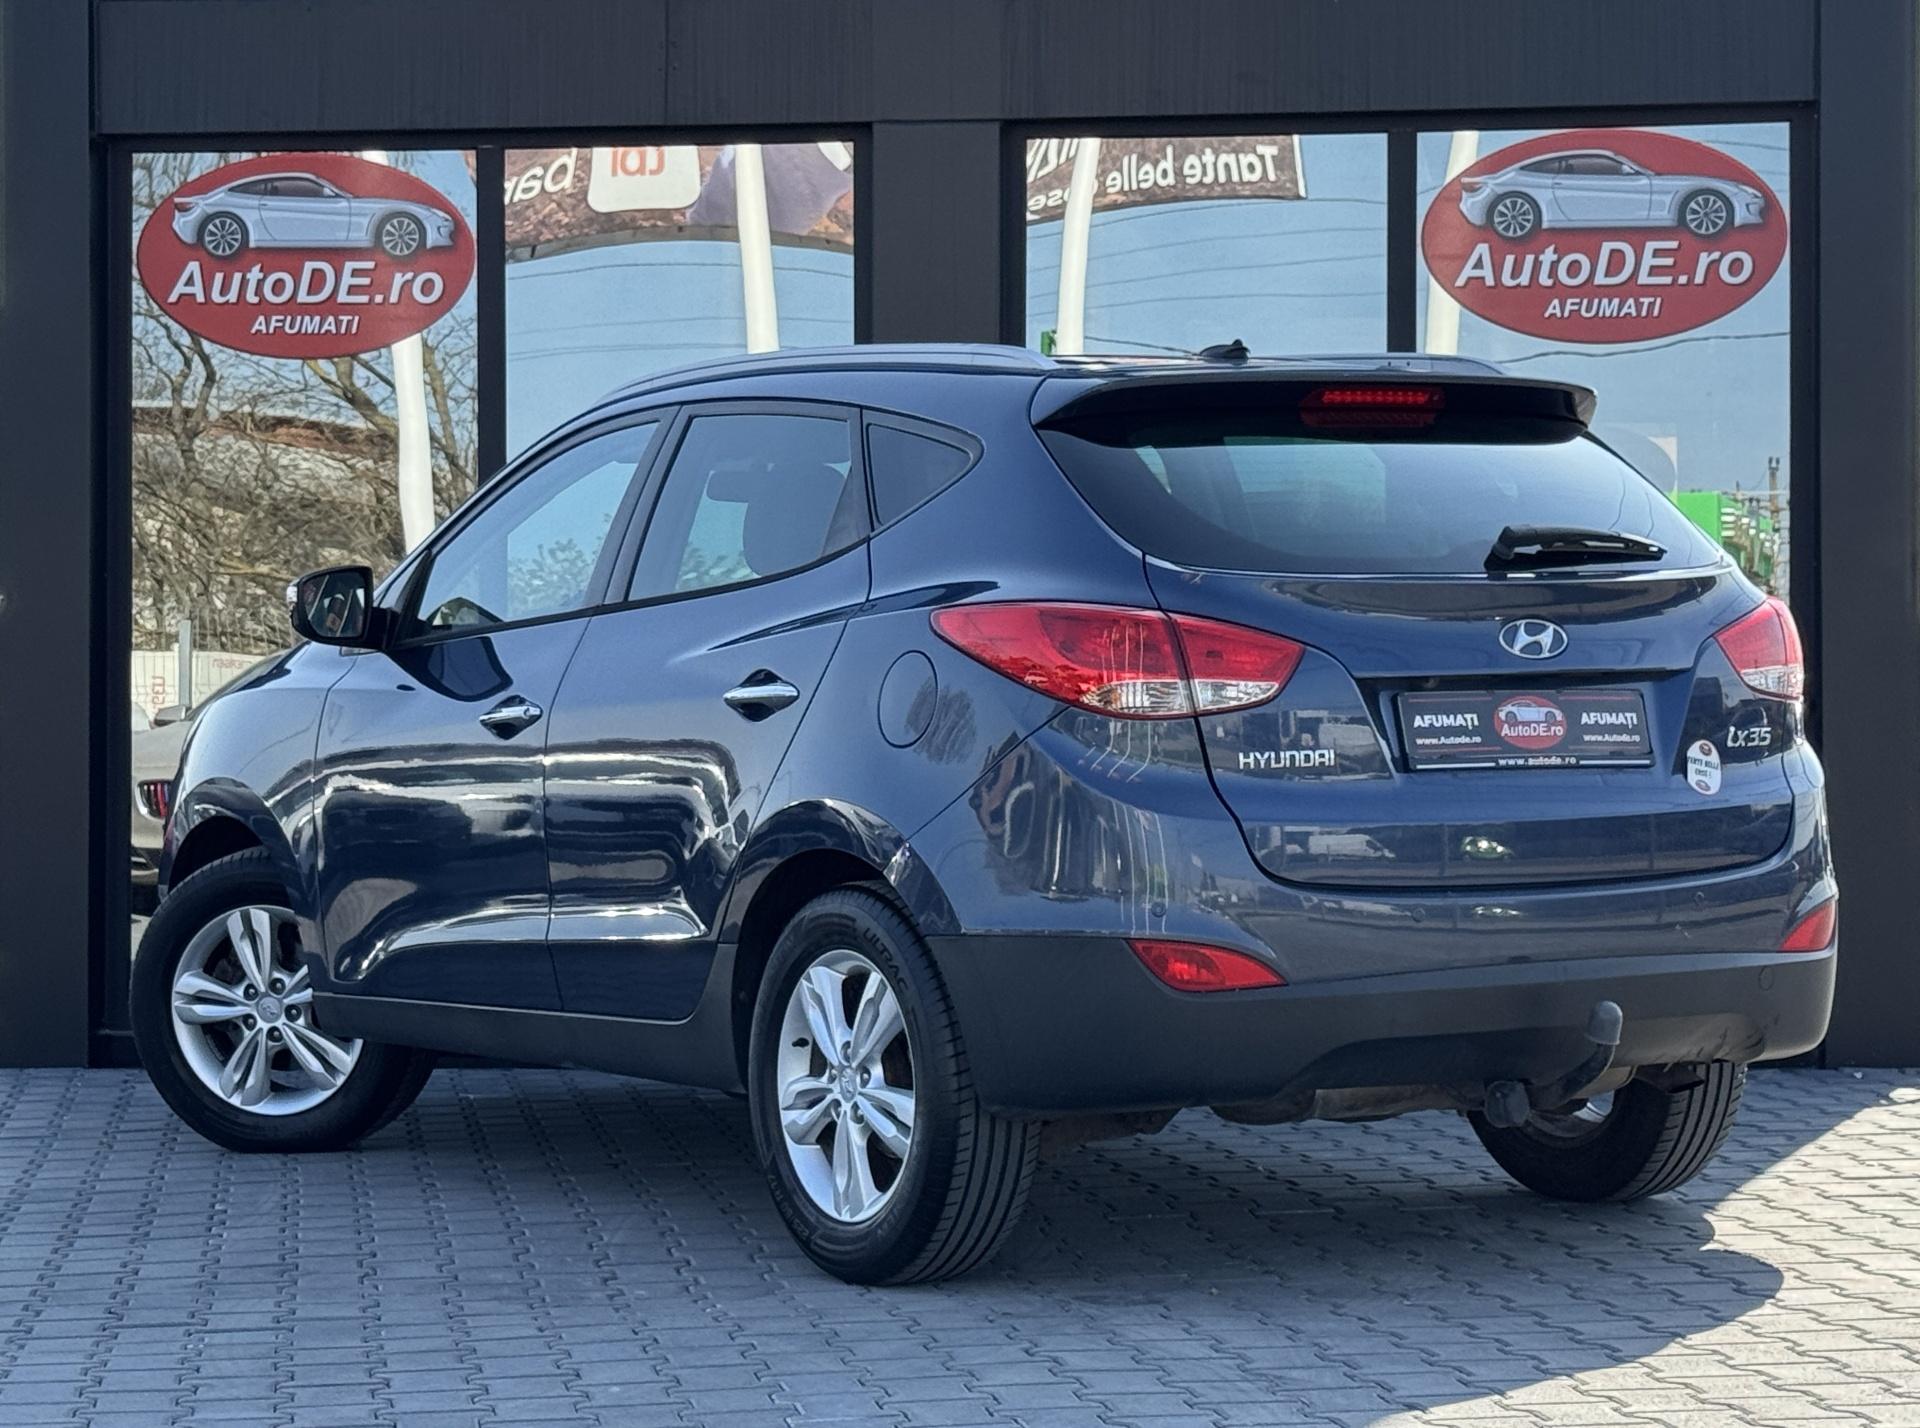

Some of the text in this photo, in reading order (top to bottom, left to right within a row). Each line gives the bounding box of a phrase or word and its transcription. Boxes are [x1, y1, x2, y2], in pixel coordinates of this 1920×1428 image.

[1455, 240, 1754, 289] AutoDE.ro
[167, 260, 445, 305] AutoDE.ro
[1544, 297, 1662, 319] AFUMATI
[250, 315, 360, 335] AFUMATI
[1501, 723, 1564, 737] AutoDE.ro
[1238, 749, 1336, 770] HYUNDAI
